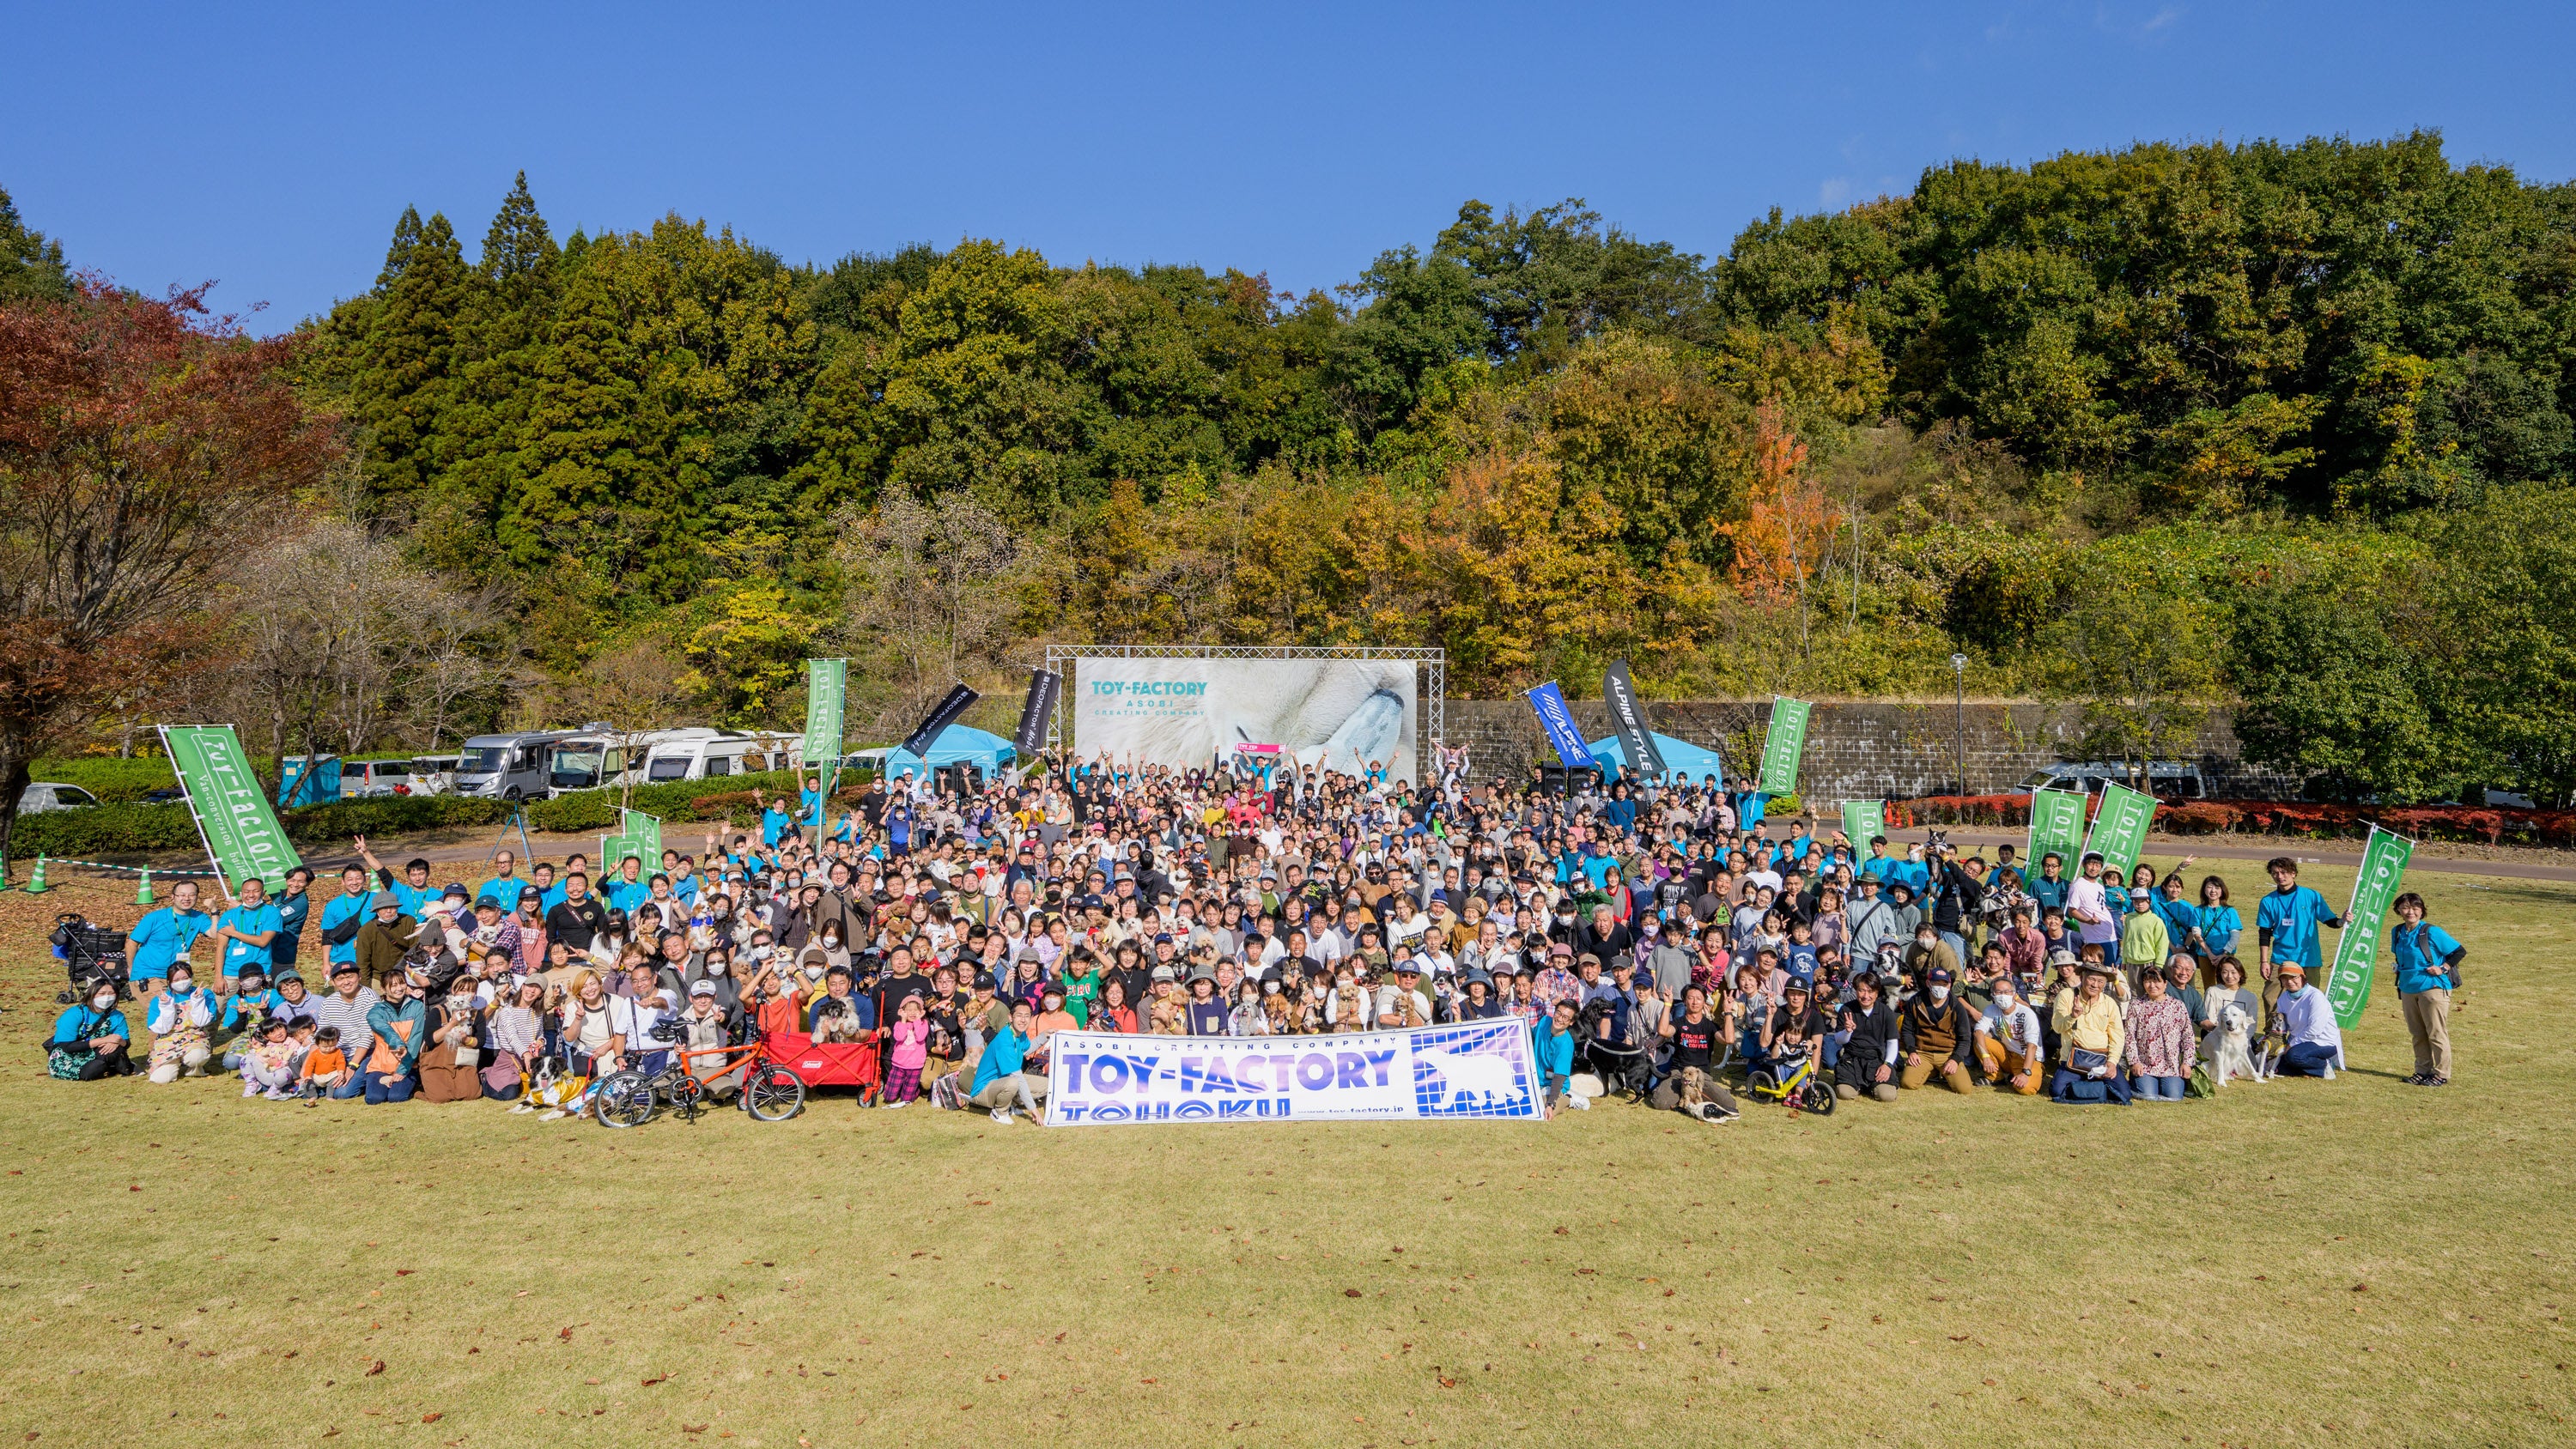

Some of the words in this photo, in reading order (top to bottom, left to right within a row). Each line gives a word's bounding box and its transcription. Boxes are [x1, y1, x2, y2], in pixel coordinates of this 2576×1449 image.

[1091, 681, 1208, 695] TOY-FACTORY
[1612, 676, 1636, 725] ALPINE
[1629, 729, 1654, 771] STYLE
[198, 774, 233, 846] Van-conversion
[1063, 1041, 1132, 1051] ASOBI
[1154, 1043, 1271, 1052] CREATING
[1292, 1037, 1396, 1049] COMPANY
[1062, 1050, 1396, 1094] TOY-FACTORY
[1060, 1098, 1291, 1121] TOHOKU
